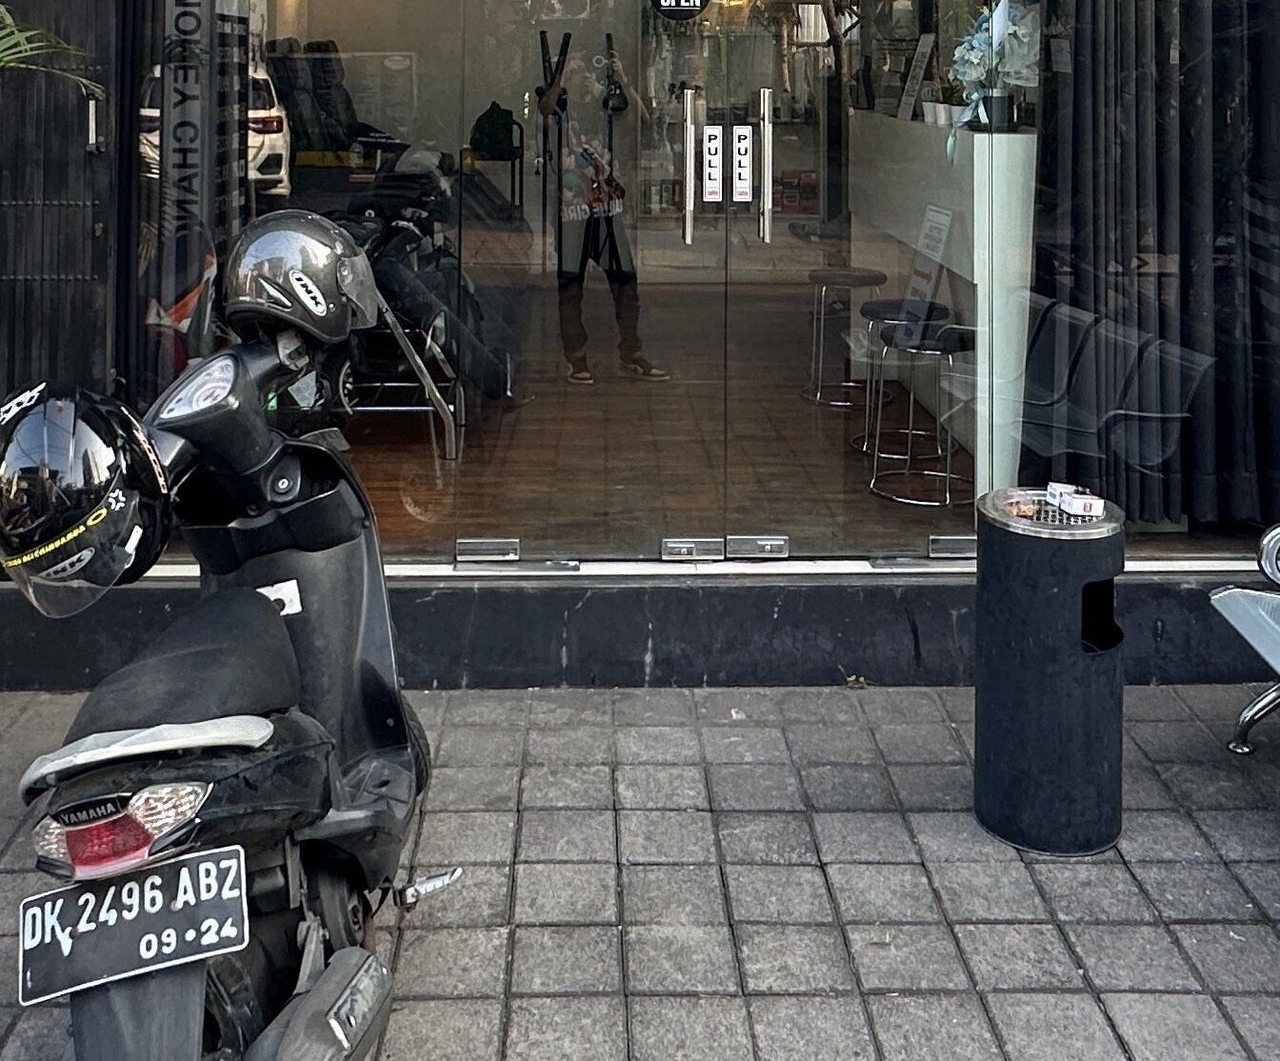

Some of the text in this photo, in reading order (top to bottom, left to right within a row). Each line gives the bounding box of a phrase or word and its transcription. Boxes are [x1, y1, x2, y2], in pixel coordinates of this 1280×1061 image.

[708, 134, 719, 182] PULL
[737, 134, 749, 182] PULL
[293, 275, 326, 310] INK
[60, 802, 118, 826] YAMAHA
[23, 858, 241, 954] DK 2496 ABZ
